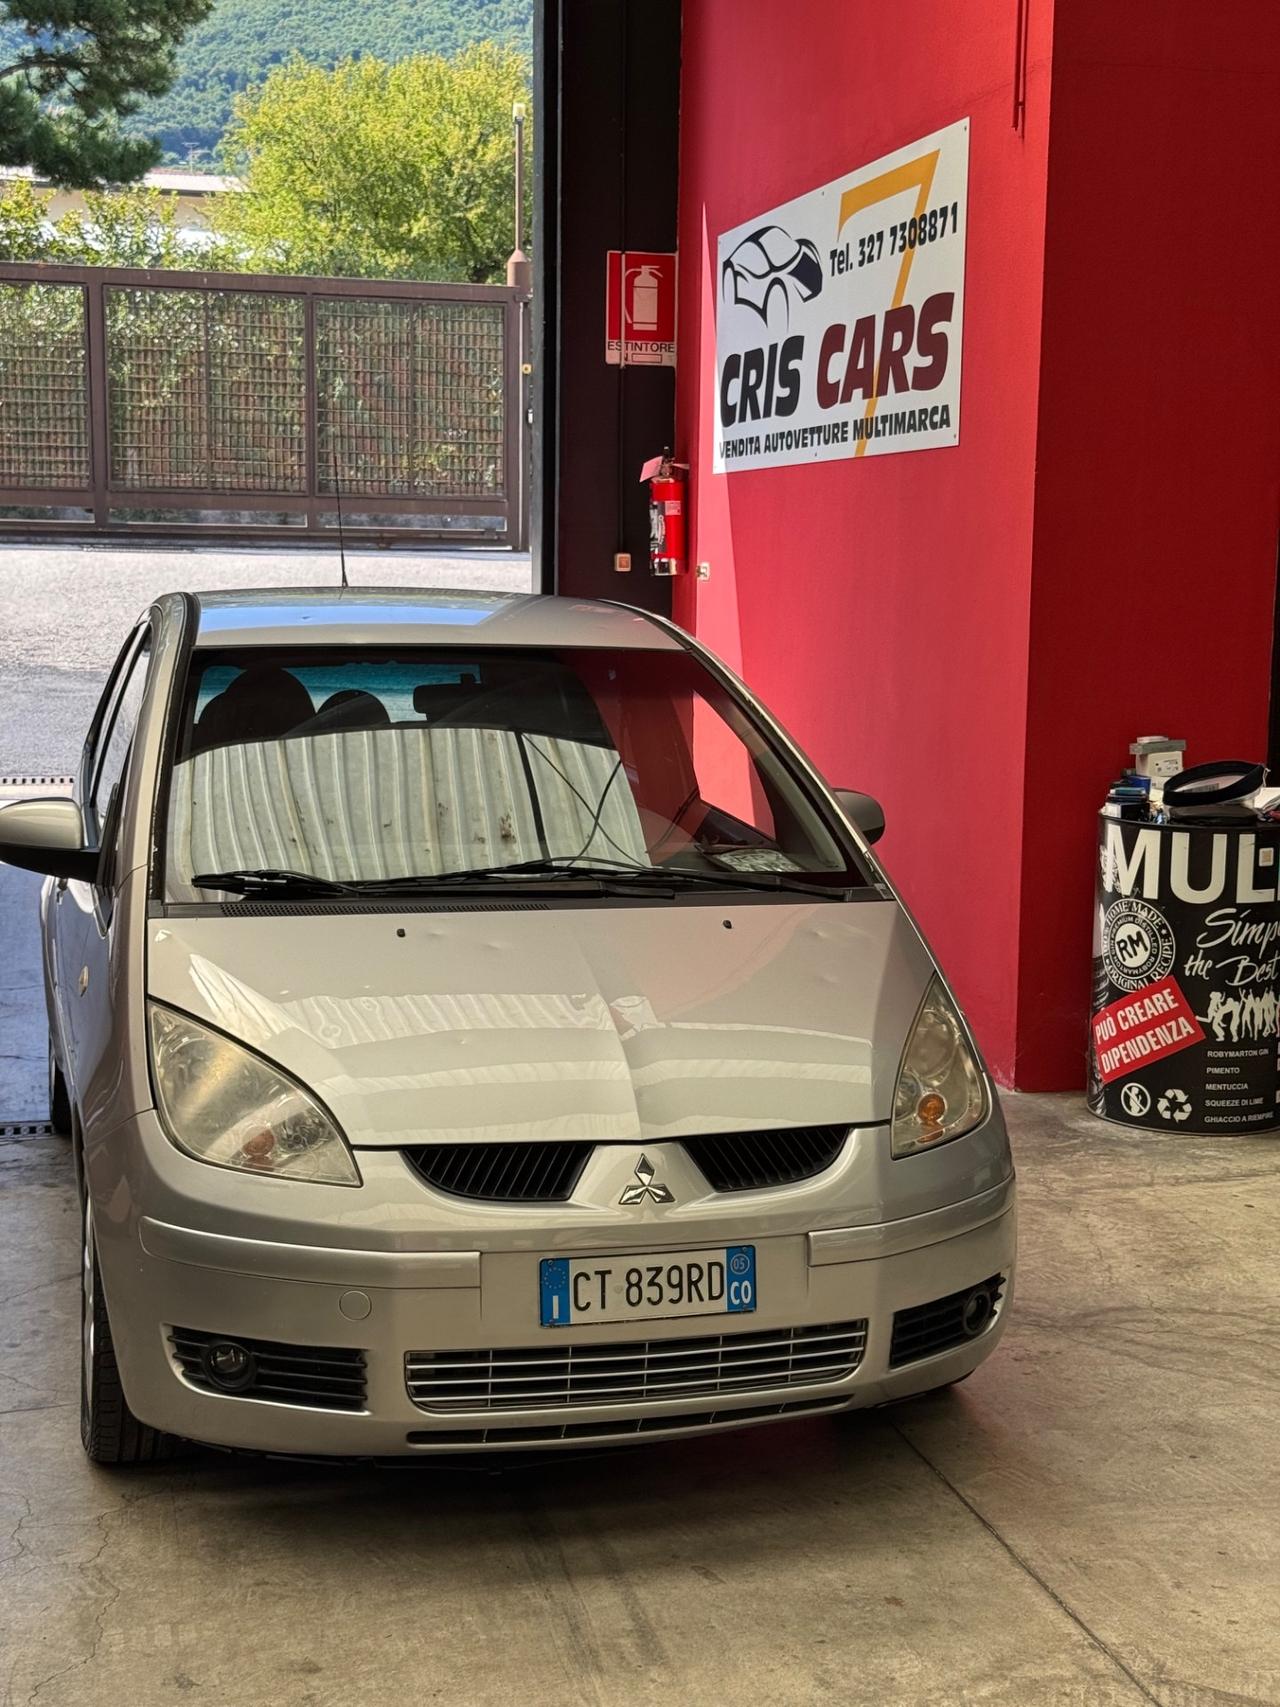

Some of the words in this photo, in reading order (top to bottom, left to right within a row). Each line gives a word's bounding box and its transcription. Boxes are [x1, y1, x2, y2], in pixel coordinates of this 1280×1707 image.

[829, 242, 853, 277] Tel.
[858, 230, 884, 268] 327
[889, 201, 957, 256] 7308871
[607, 341, 675, 353] ESTINTORE
[720, 335, 805, 428] CRIS
[816, 291, 955, 410] CARS
[719, 435, 761, 459] VENDITA
[764, 420, 849, 453] AUTOVETTURE
[853, 404, 950, 441] MULTIMARCA
[1106, 823, 1280, 904] MUL
[1131, 901, 1162, 928] MADE
[1196, 908, 1280, 959] Simp
[1116, 930, 1149, 963] RM
[1135, 916, 1158, 955] DISTILLED
[1108, 964, 1149, 990] ORIGINAL
[1150, 937, 1173, 982] RECIPE
[1184, 949, 1212, 980] the
[1215, 950, 1280, 986] Best
[1095, 1013, 1117, 1045] PUÒ
[1117, 988, 1179, 1031] CREARE
[1101, 1016, 1195, 1073] DIPENDENZA
[1207, 1050, 1258, 1058] ROBYMARTON
[1204, 1099, 1240, 1107] SQUEEZE
[1241, 1098, 1249, 1106] DI
[1204, 1115, 1240, 1123] GHIACCIO
[733, 1259, 745, 1269] 05
[573, 1269, 612, 1312] CT
[625, 1261, 725, 1307] 839RD
[730, 1280, 752, 1305] CO
[552, 1295, 559, 1319] I
